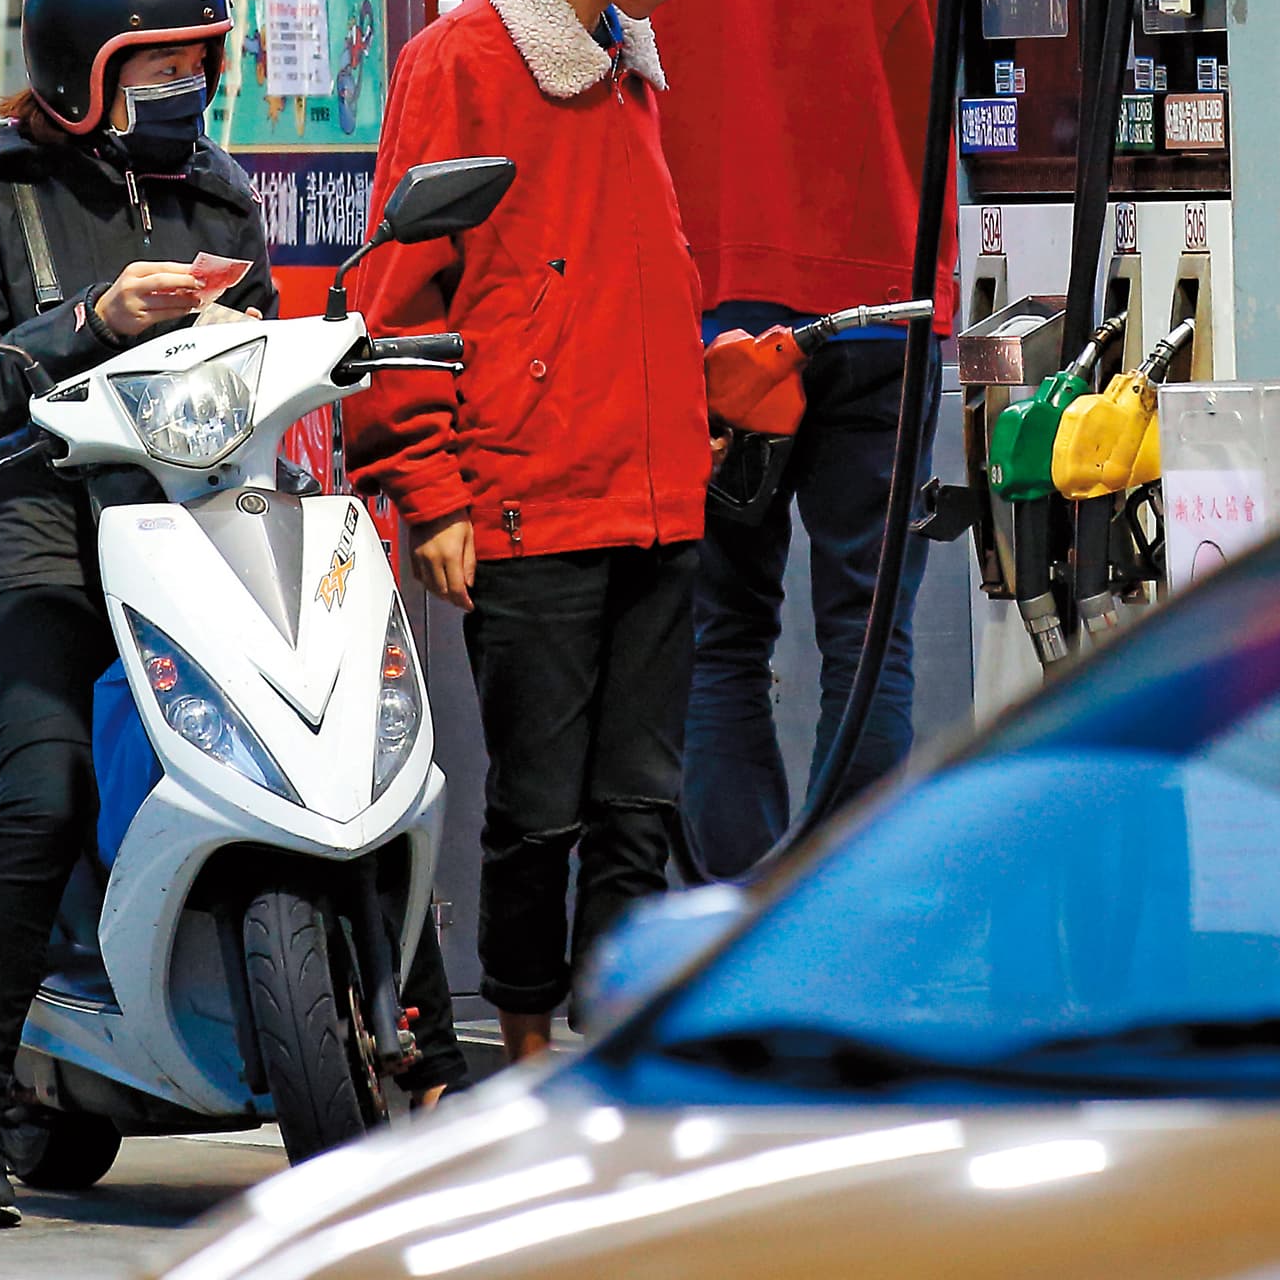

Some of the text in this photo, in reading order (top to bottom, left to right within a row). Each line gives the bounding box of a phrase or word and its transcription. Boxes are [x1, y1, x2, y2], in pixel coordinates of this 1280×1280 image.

[983, 211, 1000, 251] 504
[1117, 208, 1135, 245] 505
[1186, 208, 1206, 243] 506
[164, 341, 197, 359] SYM
[314, 550, 356, 613] RX
